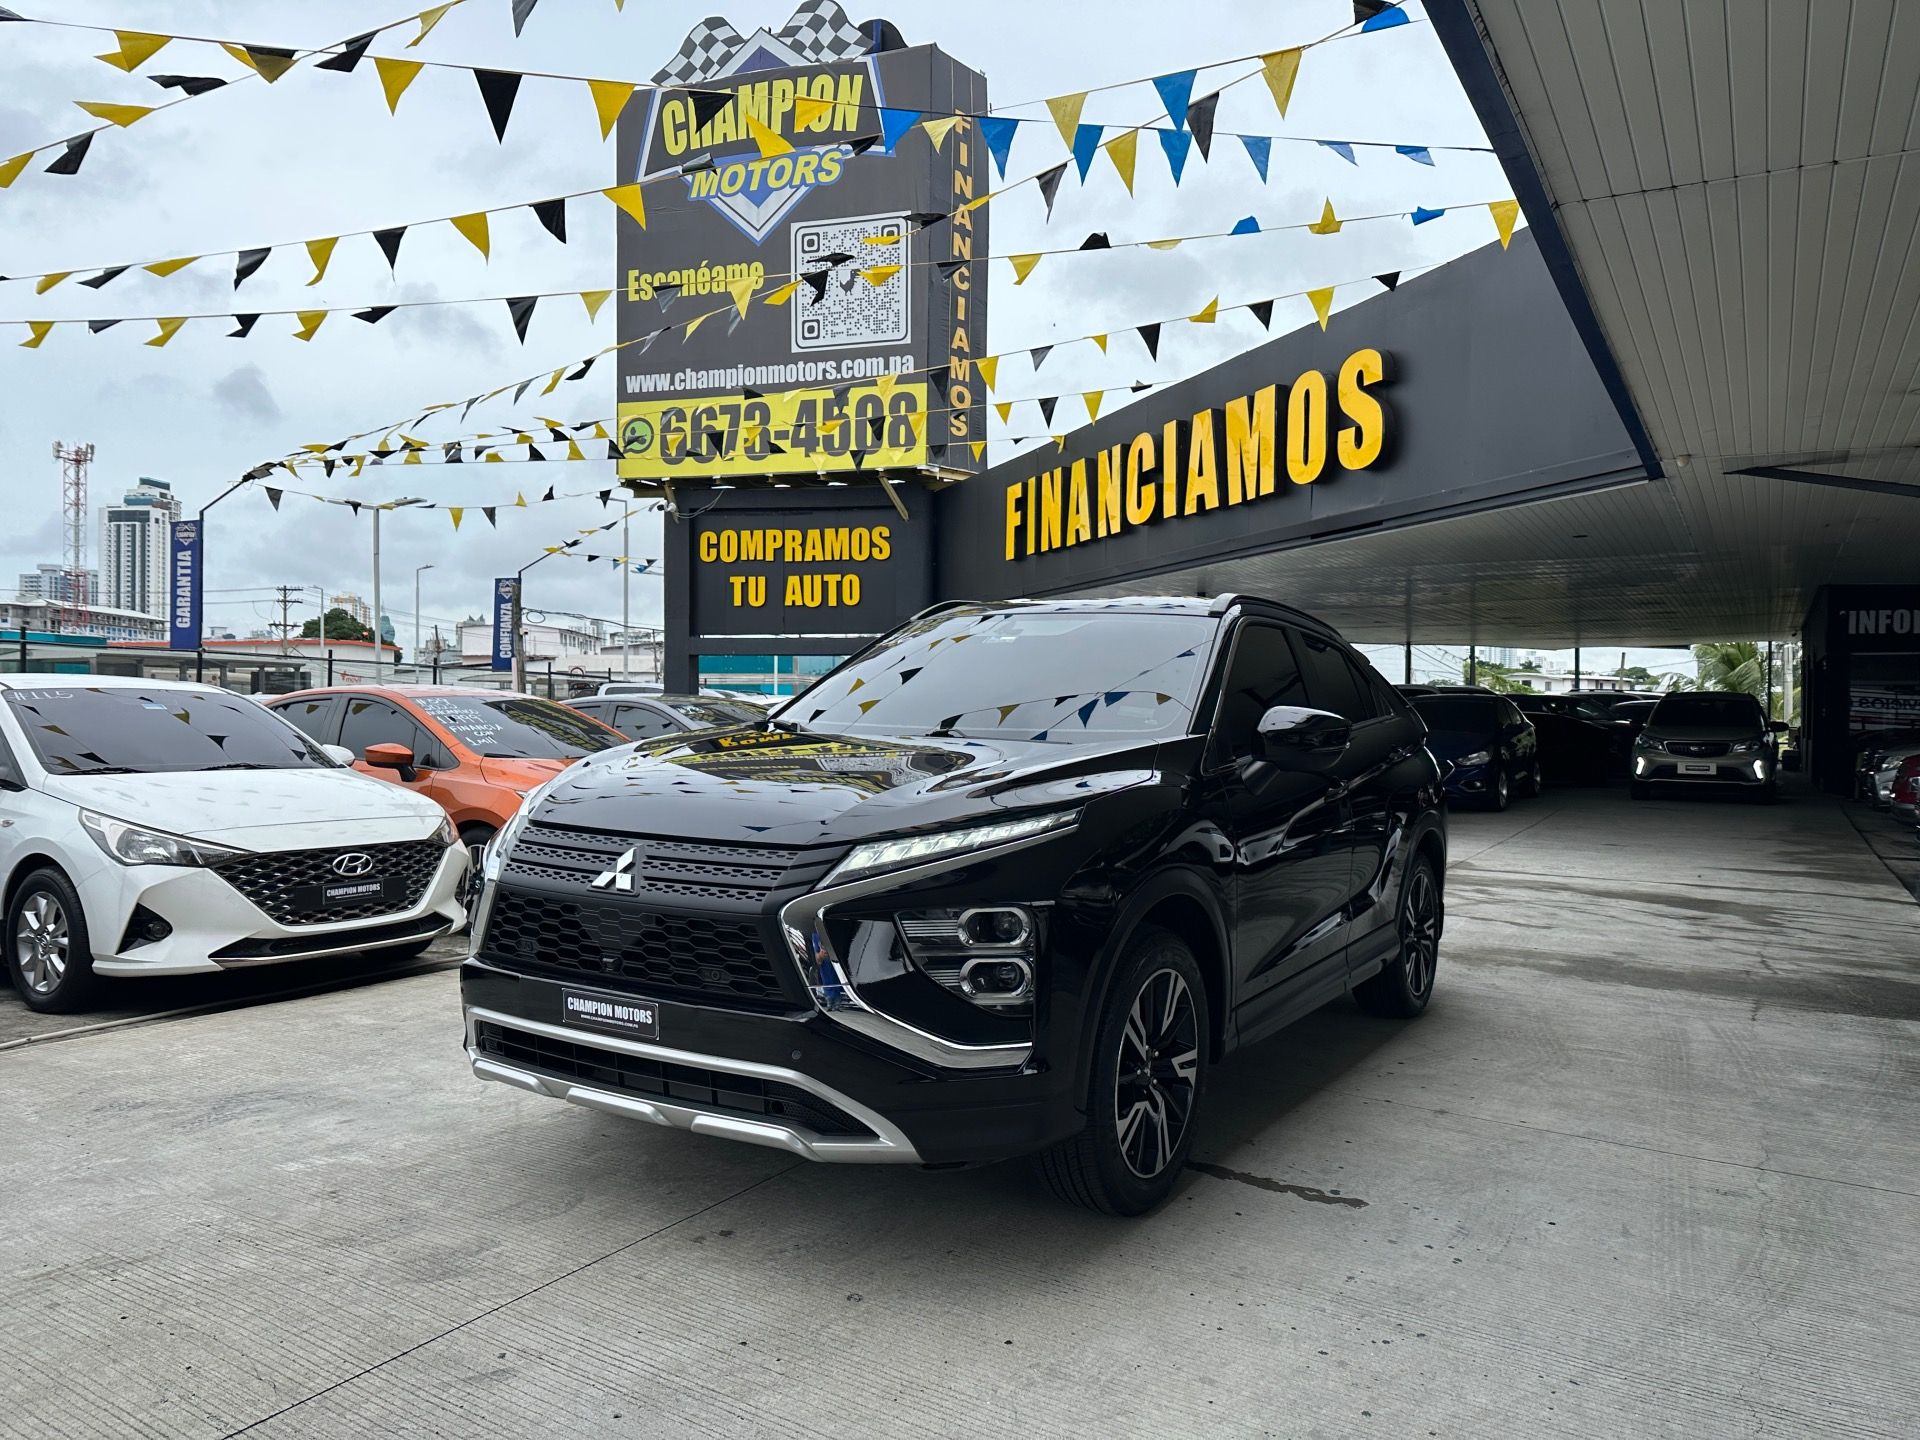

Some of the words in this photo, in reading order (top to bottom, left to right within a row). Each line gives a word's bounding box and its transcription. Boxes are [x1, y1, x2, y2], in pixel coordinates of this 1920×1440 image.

[690, 151, 842, 198] MOTORS
[628, 260, 764, 301] Escanéame
[950, 109, 973, 438] FINANCIAMOS
[626, 354, 914, 393] www.championmotors.com.pa
[660, 391, 917, 466] 6673-4508
[1006, 348, 1386, 561] FINANCIAMOS
[700, 526, 891, 563] COMPRAMOS
[175, 550, 192, 628] GARANTIA
[729, 576, 766, 608] TU
[784, 573, 861, 608] AUTO
[499, 602, 513, 659] CONFIANZA
[326, 886, 357, 897] CHAMPION
[357, 883, 381, 893] MOTORS
[567, 996, 613, 1017] CHAMPION
[614, 1005, 653, 1024] MOTORS
